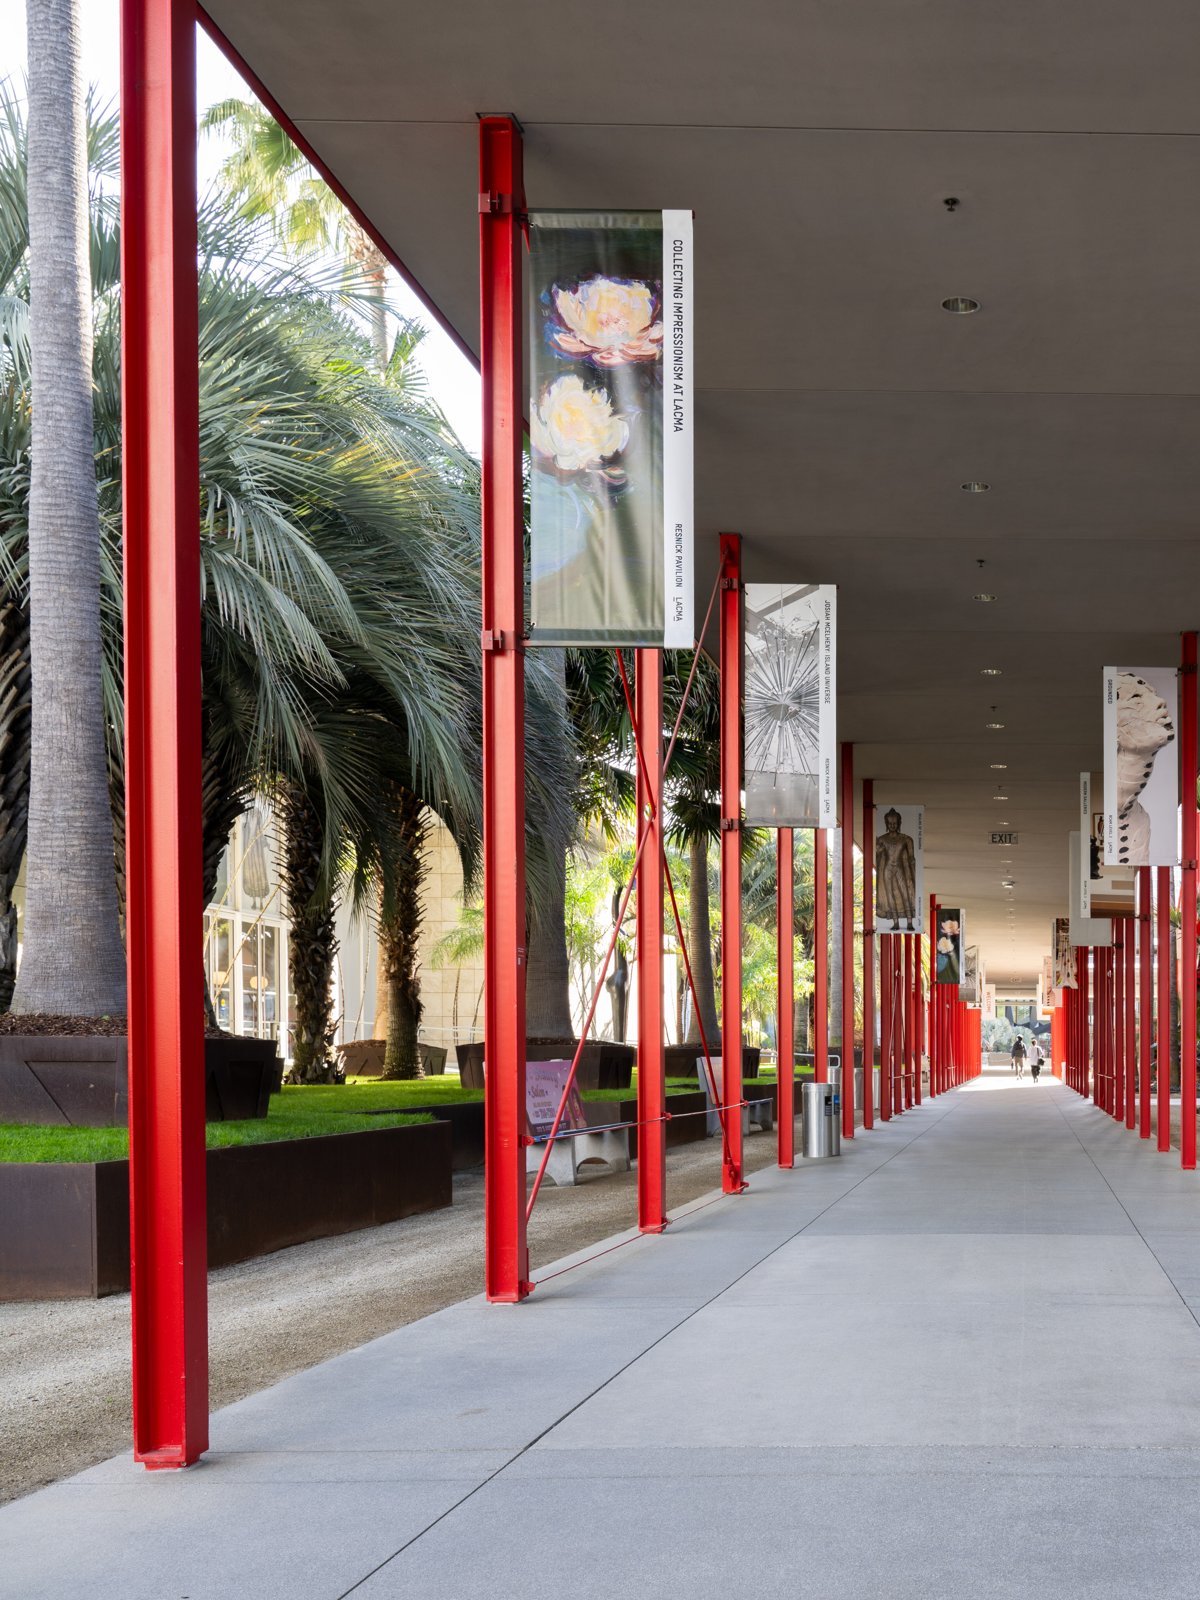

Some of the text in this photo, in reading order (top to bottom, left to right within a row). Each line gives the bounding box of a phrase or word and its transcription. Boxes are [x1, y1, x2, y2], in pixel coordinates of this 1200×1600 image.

[672, 239, 684, 433] COLLECTING IMPRESSIONISM AT LACMA
[674, 523, 683, 588] RESNICK PAVILION
[672, 596, 683, 622] LACMA
[991, 833, 1013, 844] EXIT
